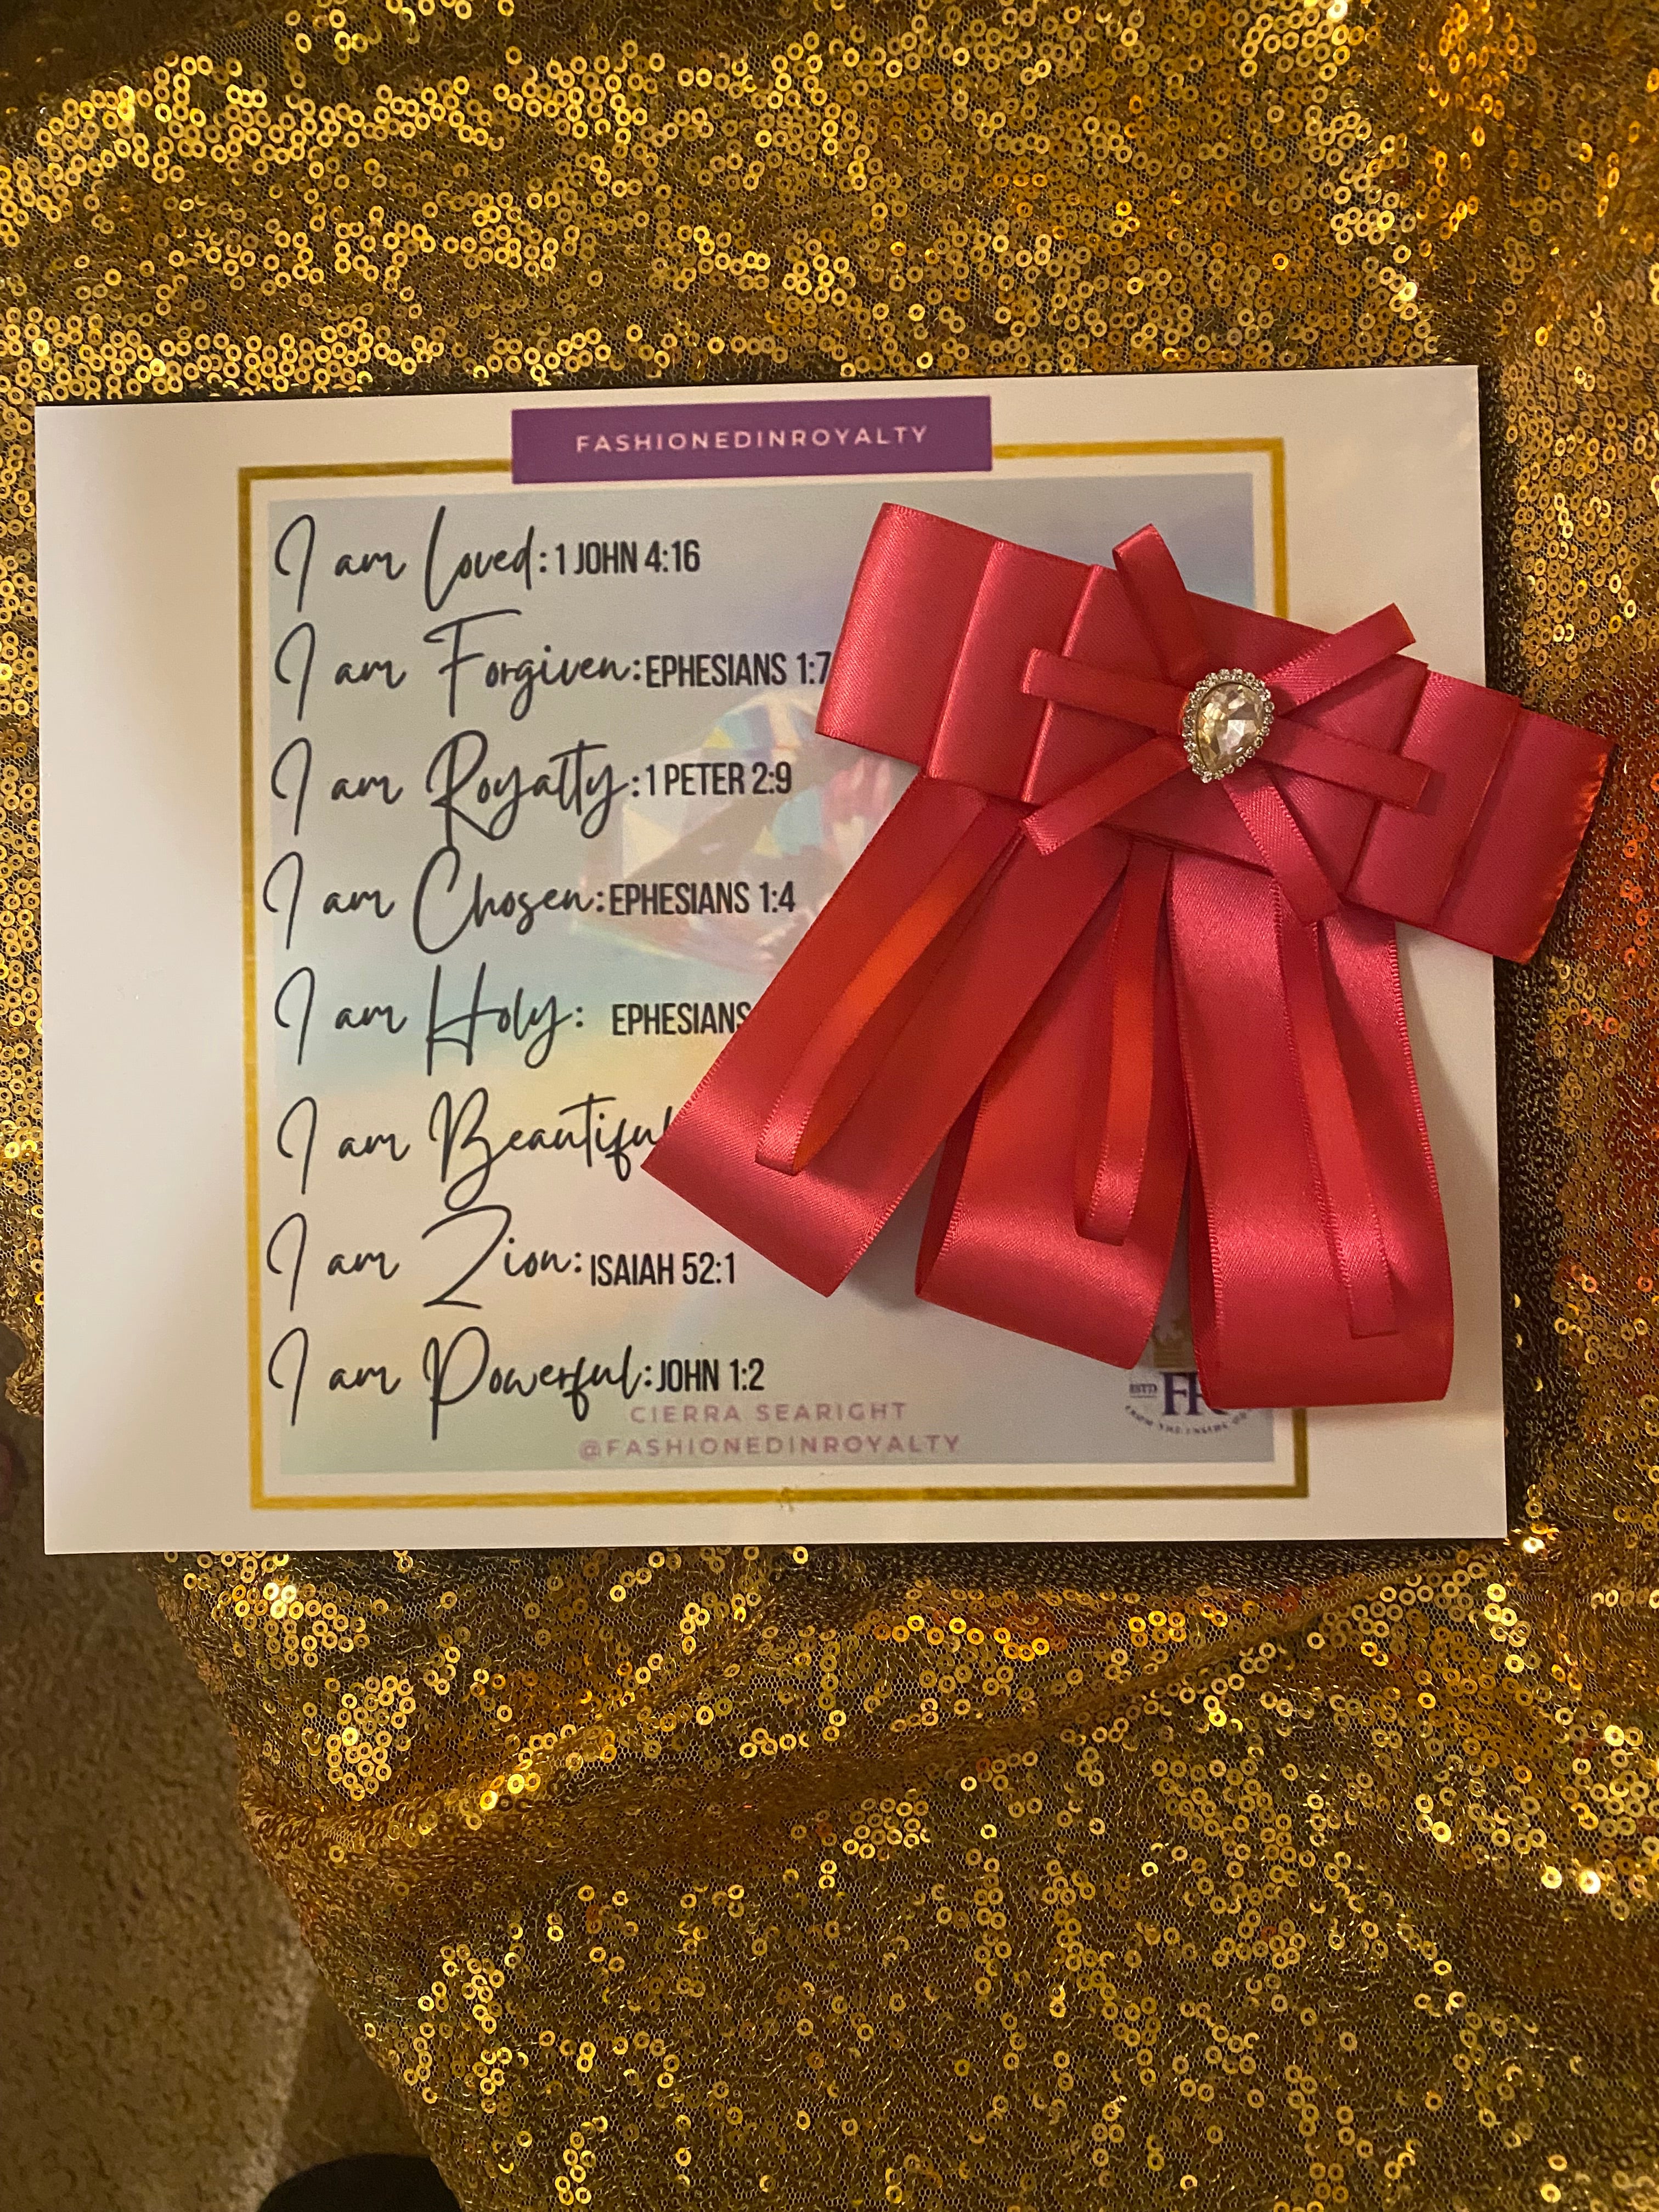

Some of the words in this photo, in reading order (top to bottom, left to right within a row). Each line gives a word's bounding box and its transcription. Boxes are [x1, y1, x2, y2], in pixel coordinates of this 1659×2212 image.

[575, 425, 928, 453] FASHIONEDINROYALTY
[274, 514, 317, 613] I
[334, 551, 408, 581] am
[424, 505, 548, 613] Loved:
[554, 542, 566, 576] 1
[573, 539, 639, 576] JOHN
[644, 538, 701, 574] 4:16
[274, 621, 317, 722] I
[334, 659, 408, 690] am
[422, 608, 642, 722] Forgiven:
[645, 651, 788, 689] EPHESIANS
[795, 650, 832, 685] 1:7
[270, 736, 313, 837] I
[330, 775, 404, 805] am
[645, 763, 656, 797] 1
[664, 761, 746, 797] PETER
[751, 760, 793, 795] 2:9
[262, 850, 304, 951] I
[322, 889, 396, 919] am
[412, 845, 606, 956] Chosen:
[608, 881, 751, 917] EPHESIANS
[758, 880, 797, 914] 1:4
[273, 966, 316, 1066] I
[334, 1005, 409, 1035] am
[425, 961, 584, 1077] Holy:
[611, 1001, 752, 1037] EPHESIANS
[276, 1096, 318, 1196] I
[337, 1132, 411, 1163] am
[266, 1211, 308, 1313] I
[326, 1251, 400, 1281] am
[422, 1204, 583, 1310] Zion:
[590, 1252, 675, 1287] ISAIAH
[681, 1251, 735, 1285] 52:1
[267, 1326, 309, 1427] I
[328, 1365, 402, 1396] am
[422, 1325, 653, 1442] Powerful:
[654, 1358, 720, 1393] JOHN
[729, 1357, 765, 1392] 1:2
[630, 1403, 741, 1424] CIERRA
[757, 1402, 907, 1423] SEARIGHT
[579, 1434, 960, 1462] @FASHIONEDINROYALTY
